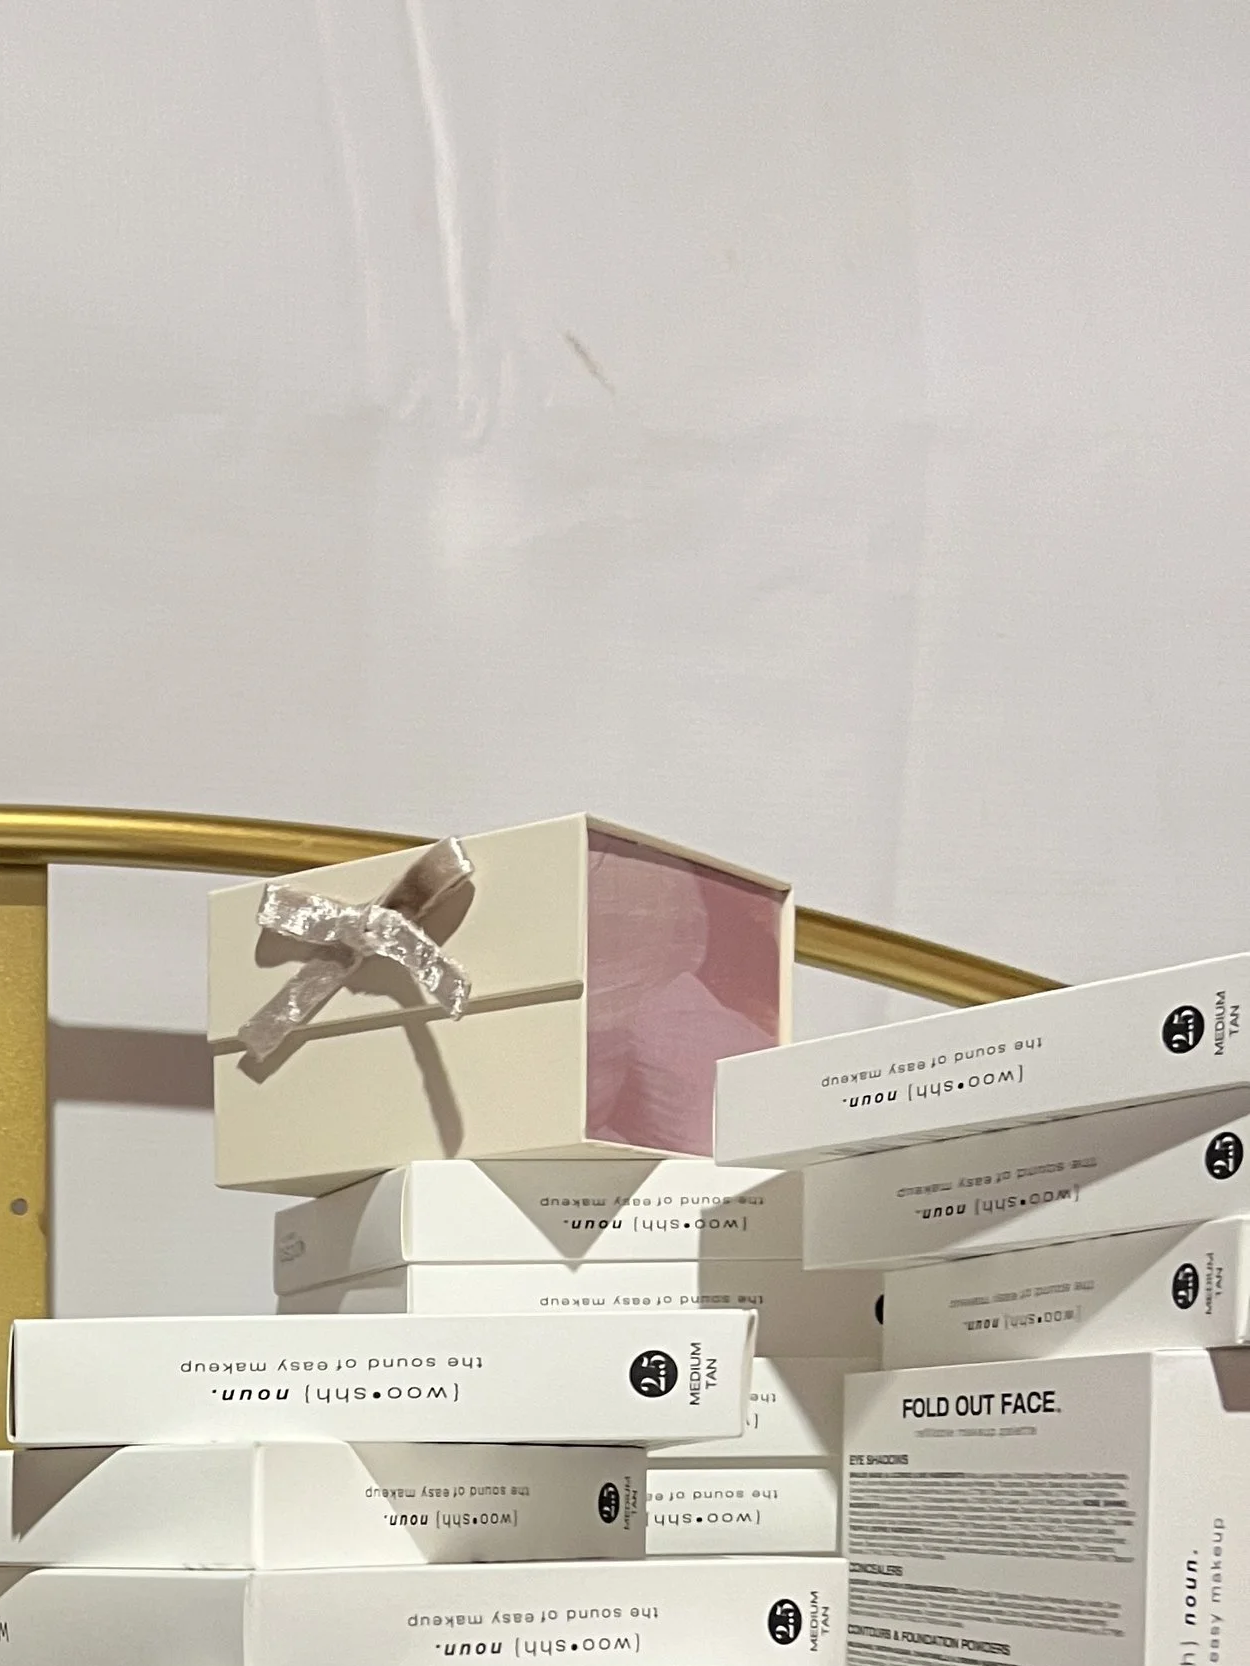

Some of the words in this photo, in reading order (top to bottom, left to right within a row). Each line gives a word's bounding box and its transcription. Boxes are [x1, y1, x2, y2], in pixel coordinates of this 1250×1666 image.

[1213, 989, 1227, 1057] MEDIUM
[1228, 1003, 1240, 1036] TAN
[1014, 1037, 1042, 1051] the
[954, 1043, 1006, 1064] sound
[889, 1060, 926, 1076] easy
[931, 1054, 947, 1069] of
[821, 1068, 882, 1088] makeup
[842, 1090, 898, 1108] noun.
[540, 1196, 606, 1208] makeup
[613, 1196, 652, 1208] easy
[656, 1196, 673, 1208] of
[680, 1196, 731, 1207] sound
[738, 1196, 765, 1206] the
[563, 1218, 623, 1230] noun.
[180, 1359, 267, 1375] makeup
[277, 1358, 329, 1372] easy
[336, 1357, 358, 1372] of
[368, 1356, 437, 1372] sound
[447, 1356, 483, 1370] the
[689, 1341, 702, 1406] MEDIUM
[705, 1358, 718, 1390] TAN
[211, 1386, 290, 1401] noun.
[902, 1397, 950, 1419] FOLD
[955, 1393, 996, 1416] OUT
[1000, 1390, 1062, 1415] FACE.
[669, 1491, 686, 1503] of
[693, 1490, 744, 1500] sound
[752, 1489, 778, 1499] the
[383, 1513, 429, 1526] noun.
[1210, 1517, 1226, 1603] makeup
[1184, 1549, 1199, 1626] noun.
[407, 1613, 483, 1628] makeup
[491, 1611, 535, 1626] easy
[540, 1609, 559, 1624] of
[565, 1607, 622, 1623] sound
[630, 1607, 659, 1620] the
[809, 1590, 819, 1652] MEDIUM
[821, 1605, 831, 1635] TAN
[435, 1640, 503, 1657] noun.
